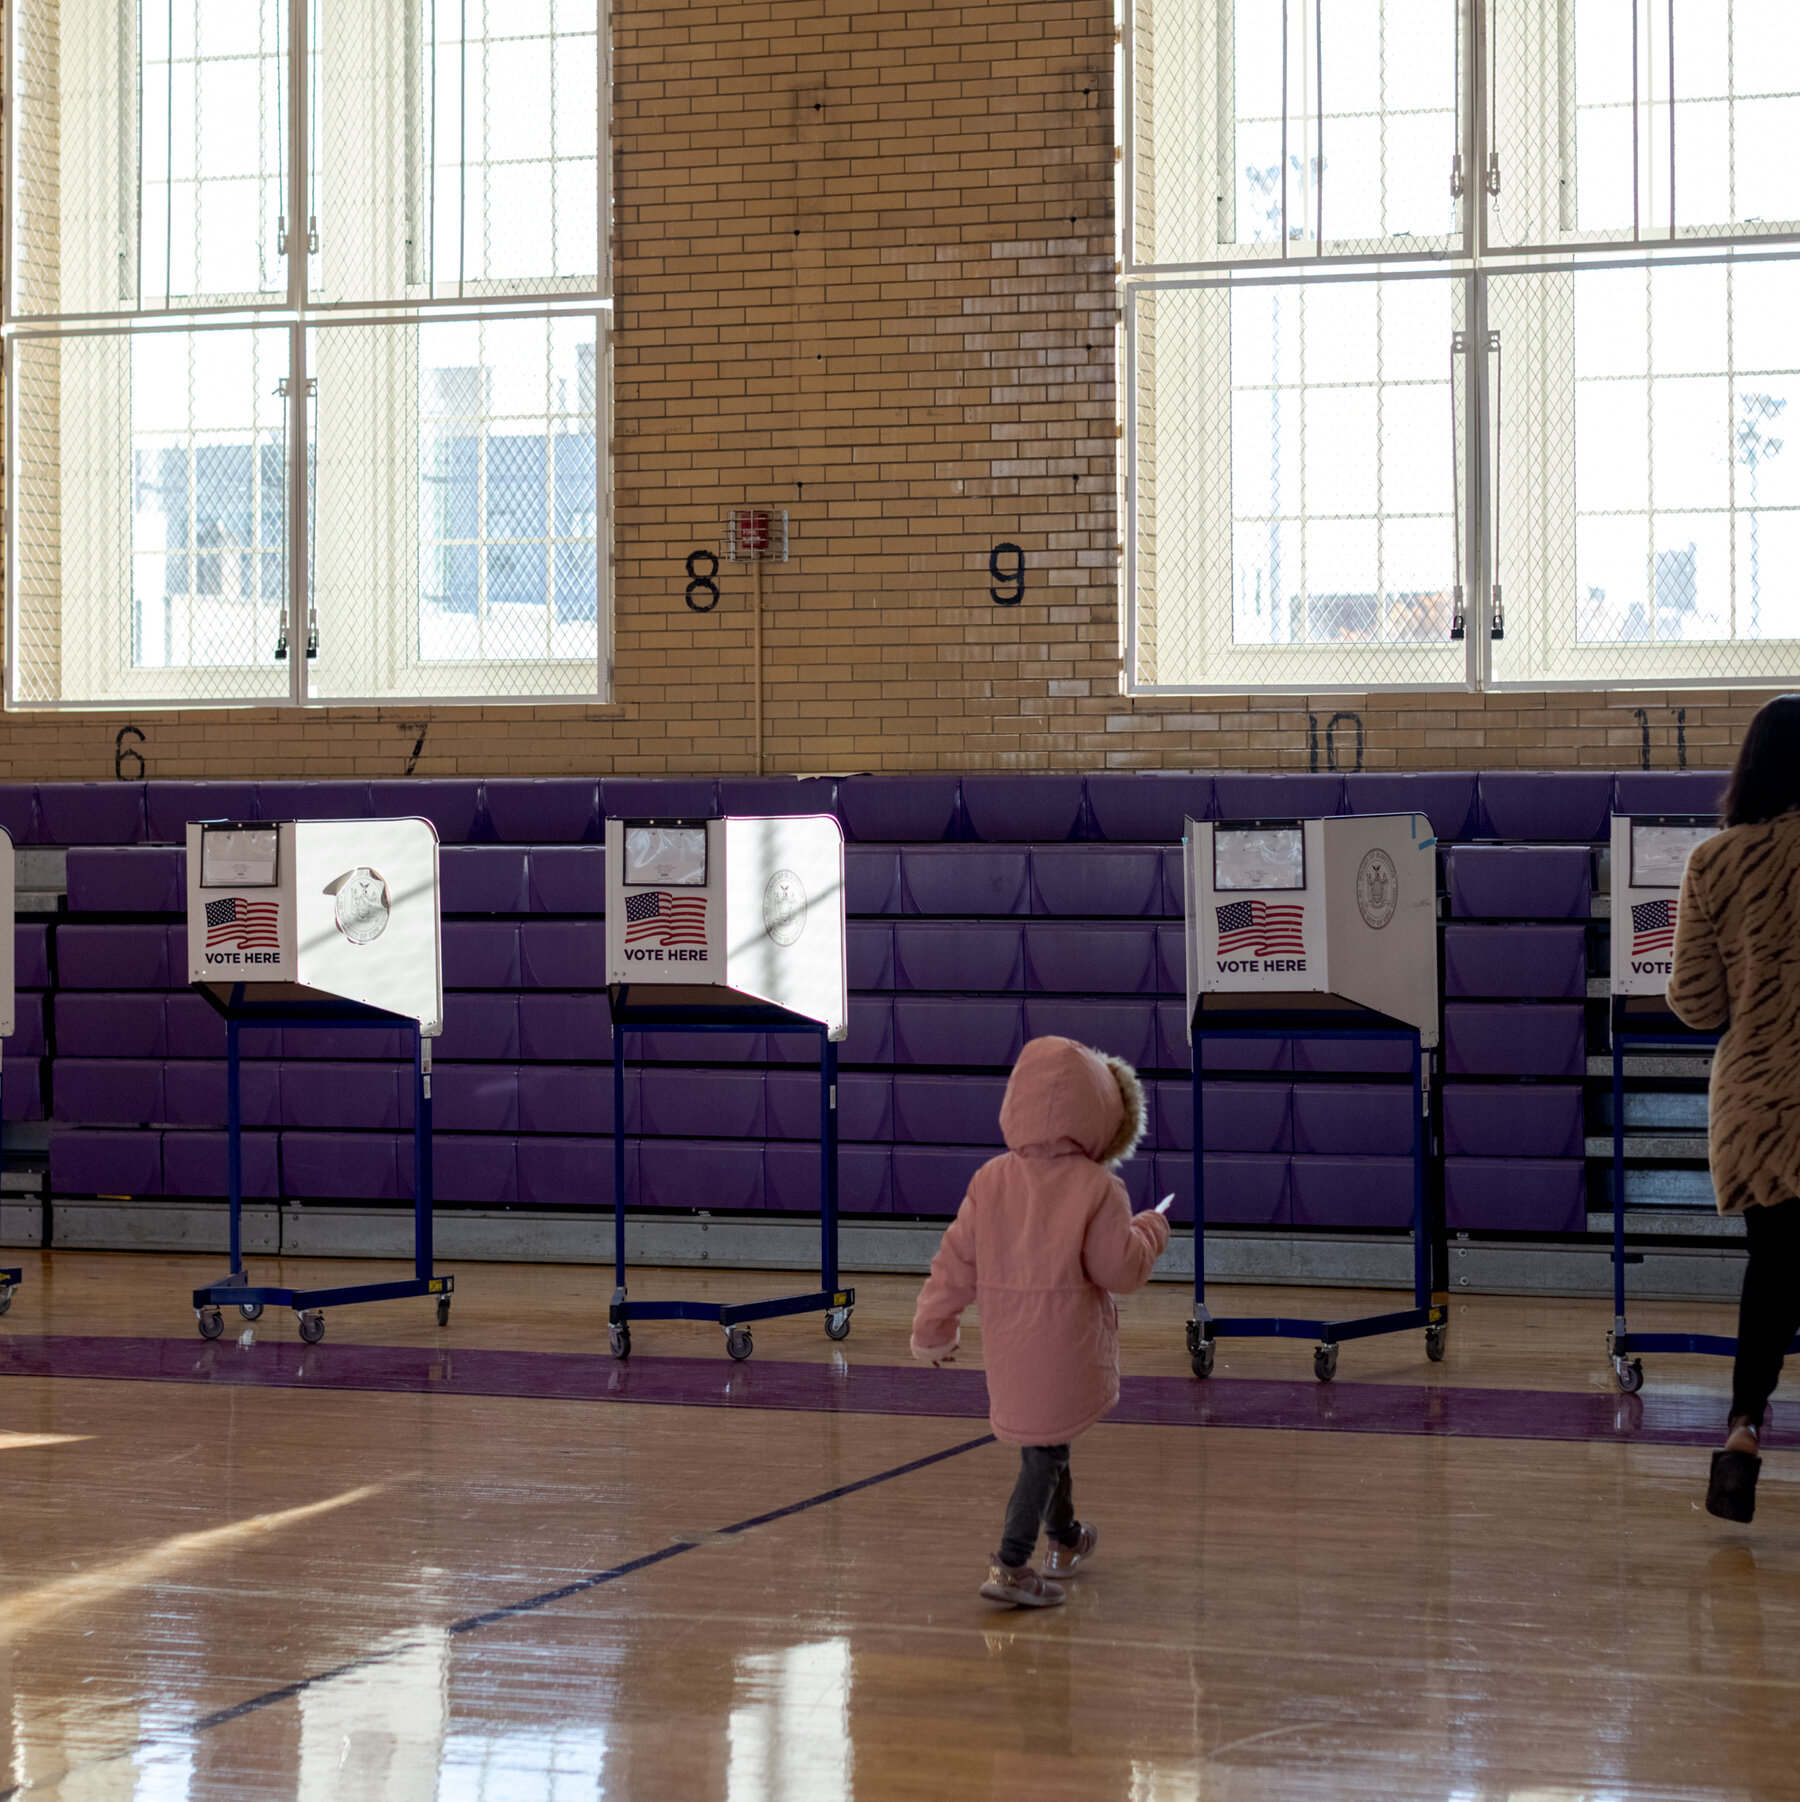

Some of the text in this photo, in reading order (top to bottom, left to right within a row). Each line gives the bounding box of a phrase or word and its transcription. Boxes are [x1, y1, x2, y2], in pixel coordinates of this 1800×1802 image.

[684, 550, 720, 613] 8
[989, 542, 1026, 607] 9
[115, 725, 146, 782] 6
[397, 723, 428, 776] 7
[1310, 711, 1364, 774] 10
[1629, 708, 1687, 771] 11
[205, 952, 280, 964] VOTE HERE
[624, 949, 708, 960] VOTE HERE
[1216, 959, 1306, 973] VOTE HERE
[1631, 961, 1673, 974] VOTE
